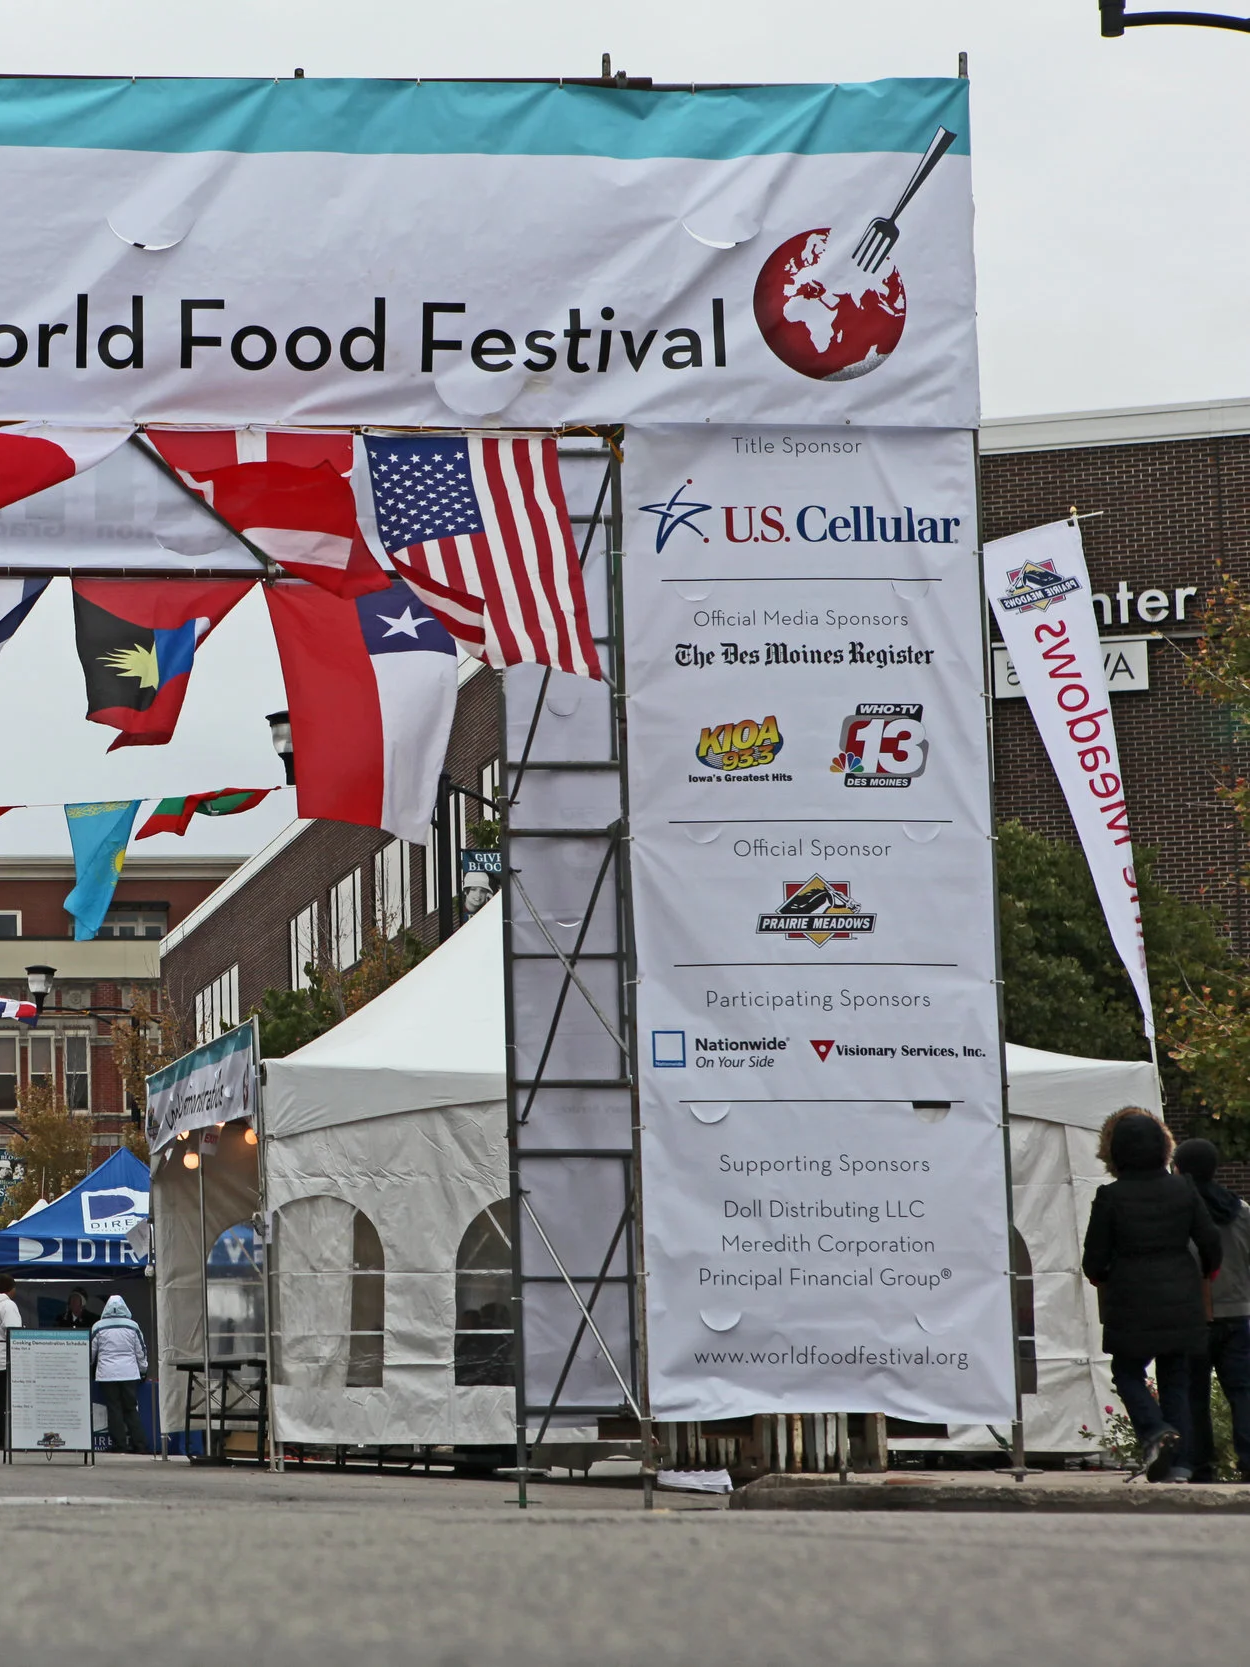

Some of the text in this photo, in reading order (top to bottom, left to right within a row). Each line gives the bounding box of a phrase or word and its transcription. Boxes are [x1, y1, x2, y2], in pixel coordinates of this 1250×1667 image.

[180, 296, 387, 373] Food
[421, 297, 727, 374] Festival
[731, 437, 863, 457] Title Sponsor
[721, 505, 791, 543] U.S.
[1092, 580, 1198, 625] nter
[694, 610, 909, 629] Official Media Sponsors
[675, 642, 935, 669] The Des Moines Register
[698, 715, 782, 758] KIOA
[854, 718, 927, 775] 13
[722, 745, 775, 771] 93.3
[688, 773, 793, 783] Iowa's Greatest Hits
[846, 778, 909, 788] DES MOINES
[733, 839, 892, 860] Official Sponsor
[469, 861, 502, 872] BLOO
[762, 917, 871, 930] PRAIRIE MEADOWS
[706, 989, 931, 1011] Participating Sponsors
[695, 1056, 775, 1068] On Your Side
[835, 1045, 987, 1059] Visionary Services, Inc.
[719, 1154, 931, 1176] Supporting Sponsors
[724, 1200, 926, 1222] Doll Distributing LLC
[91, 1219, 141, 1229] DIRE
[722, 1234, 935, 1257] Meredith Corporation
[699, 1268, 782, 1290] Principal
[790, 1268, 873, 1286] Financial
[694, 1345, 969, 1370] www.worldfoodfestival.org
